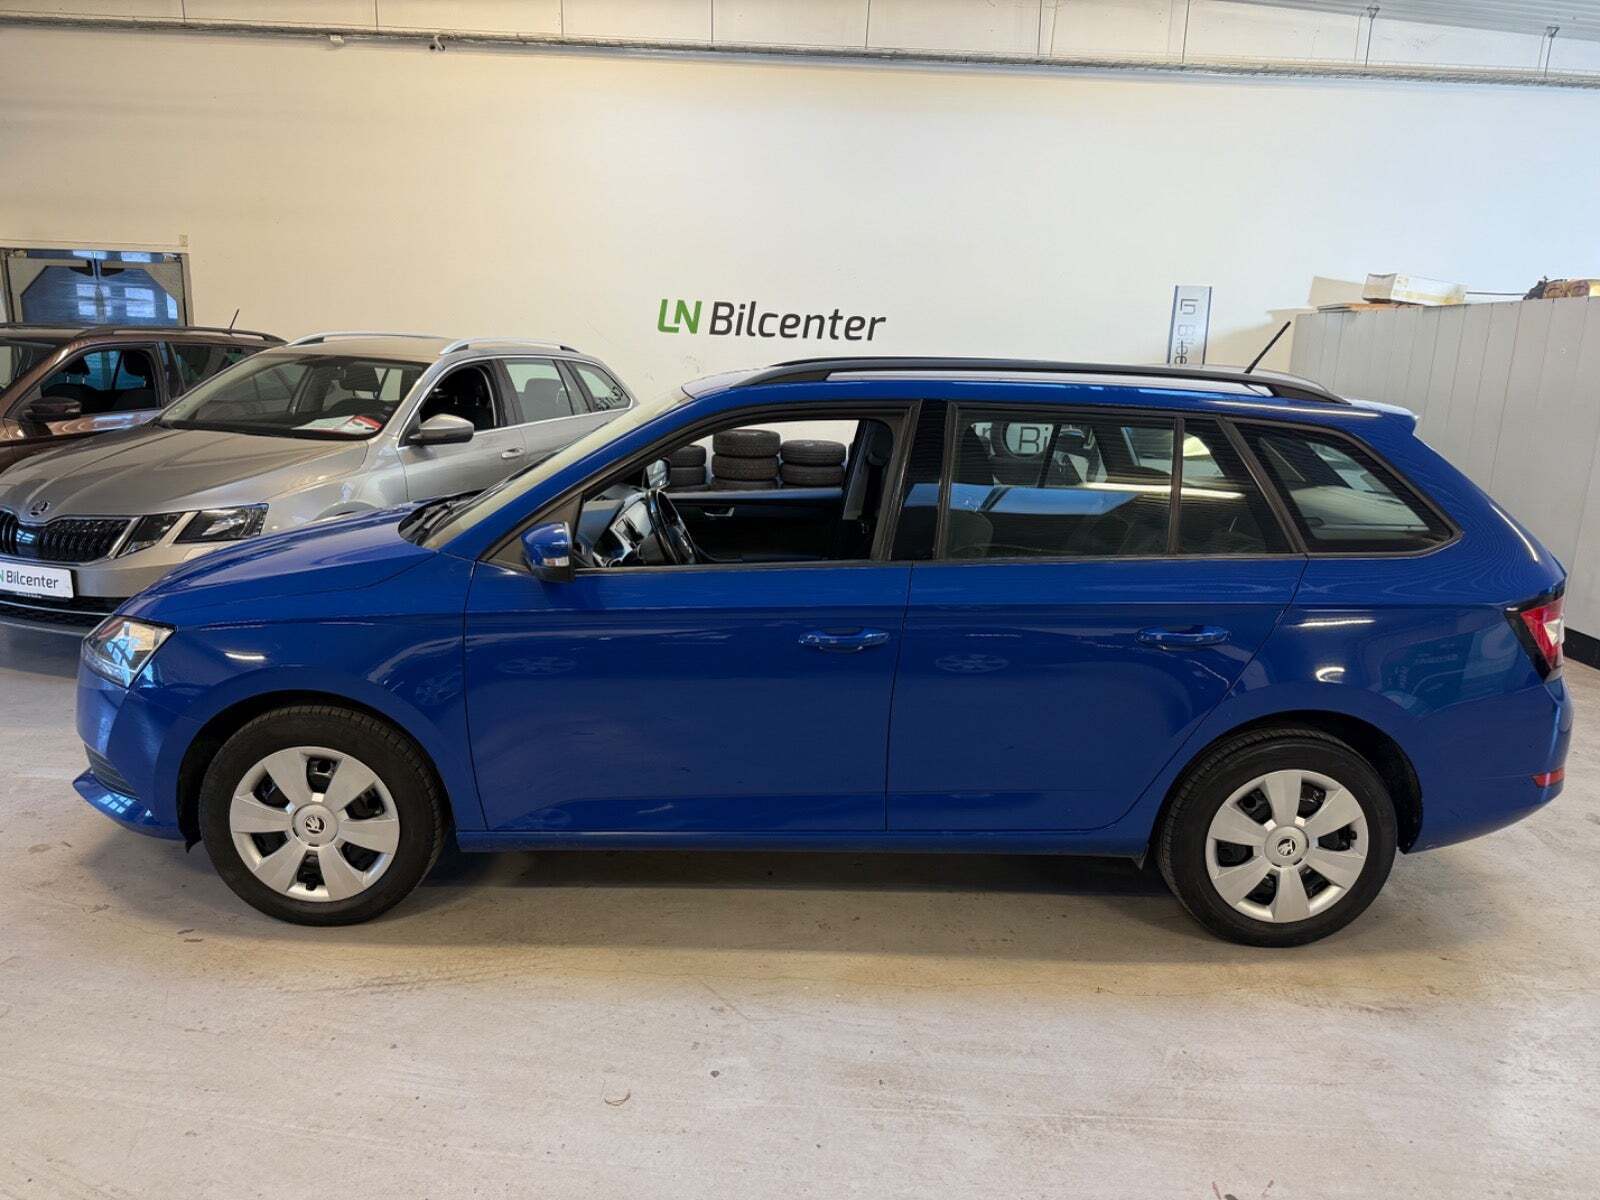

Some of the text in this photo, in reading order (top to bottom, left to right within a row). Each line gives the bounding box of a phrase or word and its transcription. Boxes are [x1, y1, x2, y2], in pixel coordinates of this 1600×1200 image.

[657, 298, 887, 341] LN Bilcenter
[6, 570, 59, 589] Bilcenter
